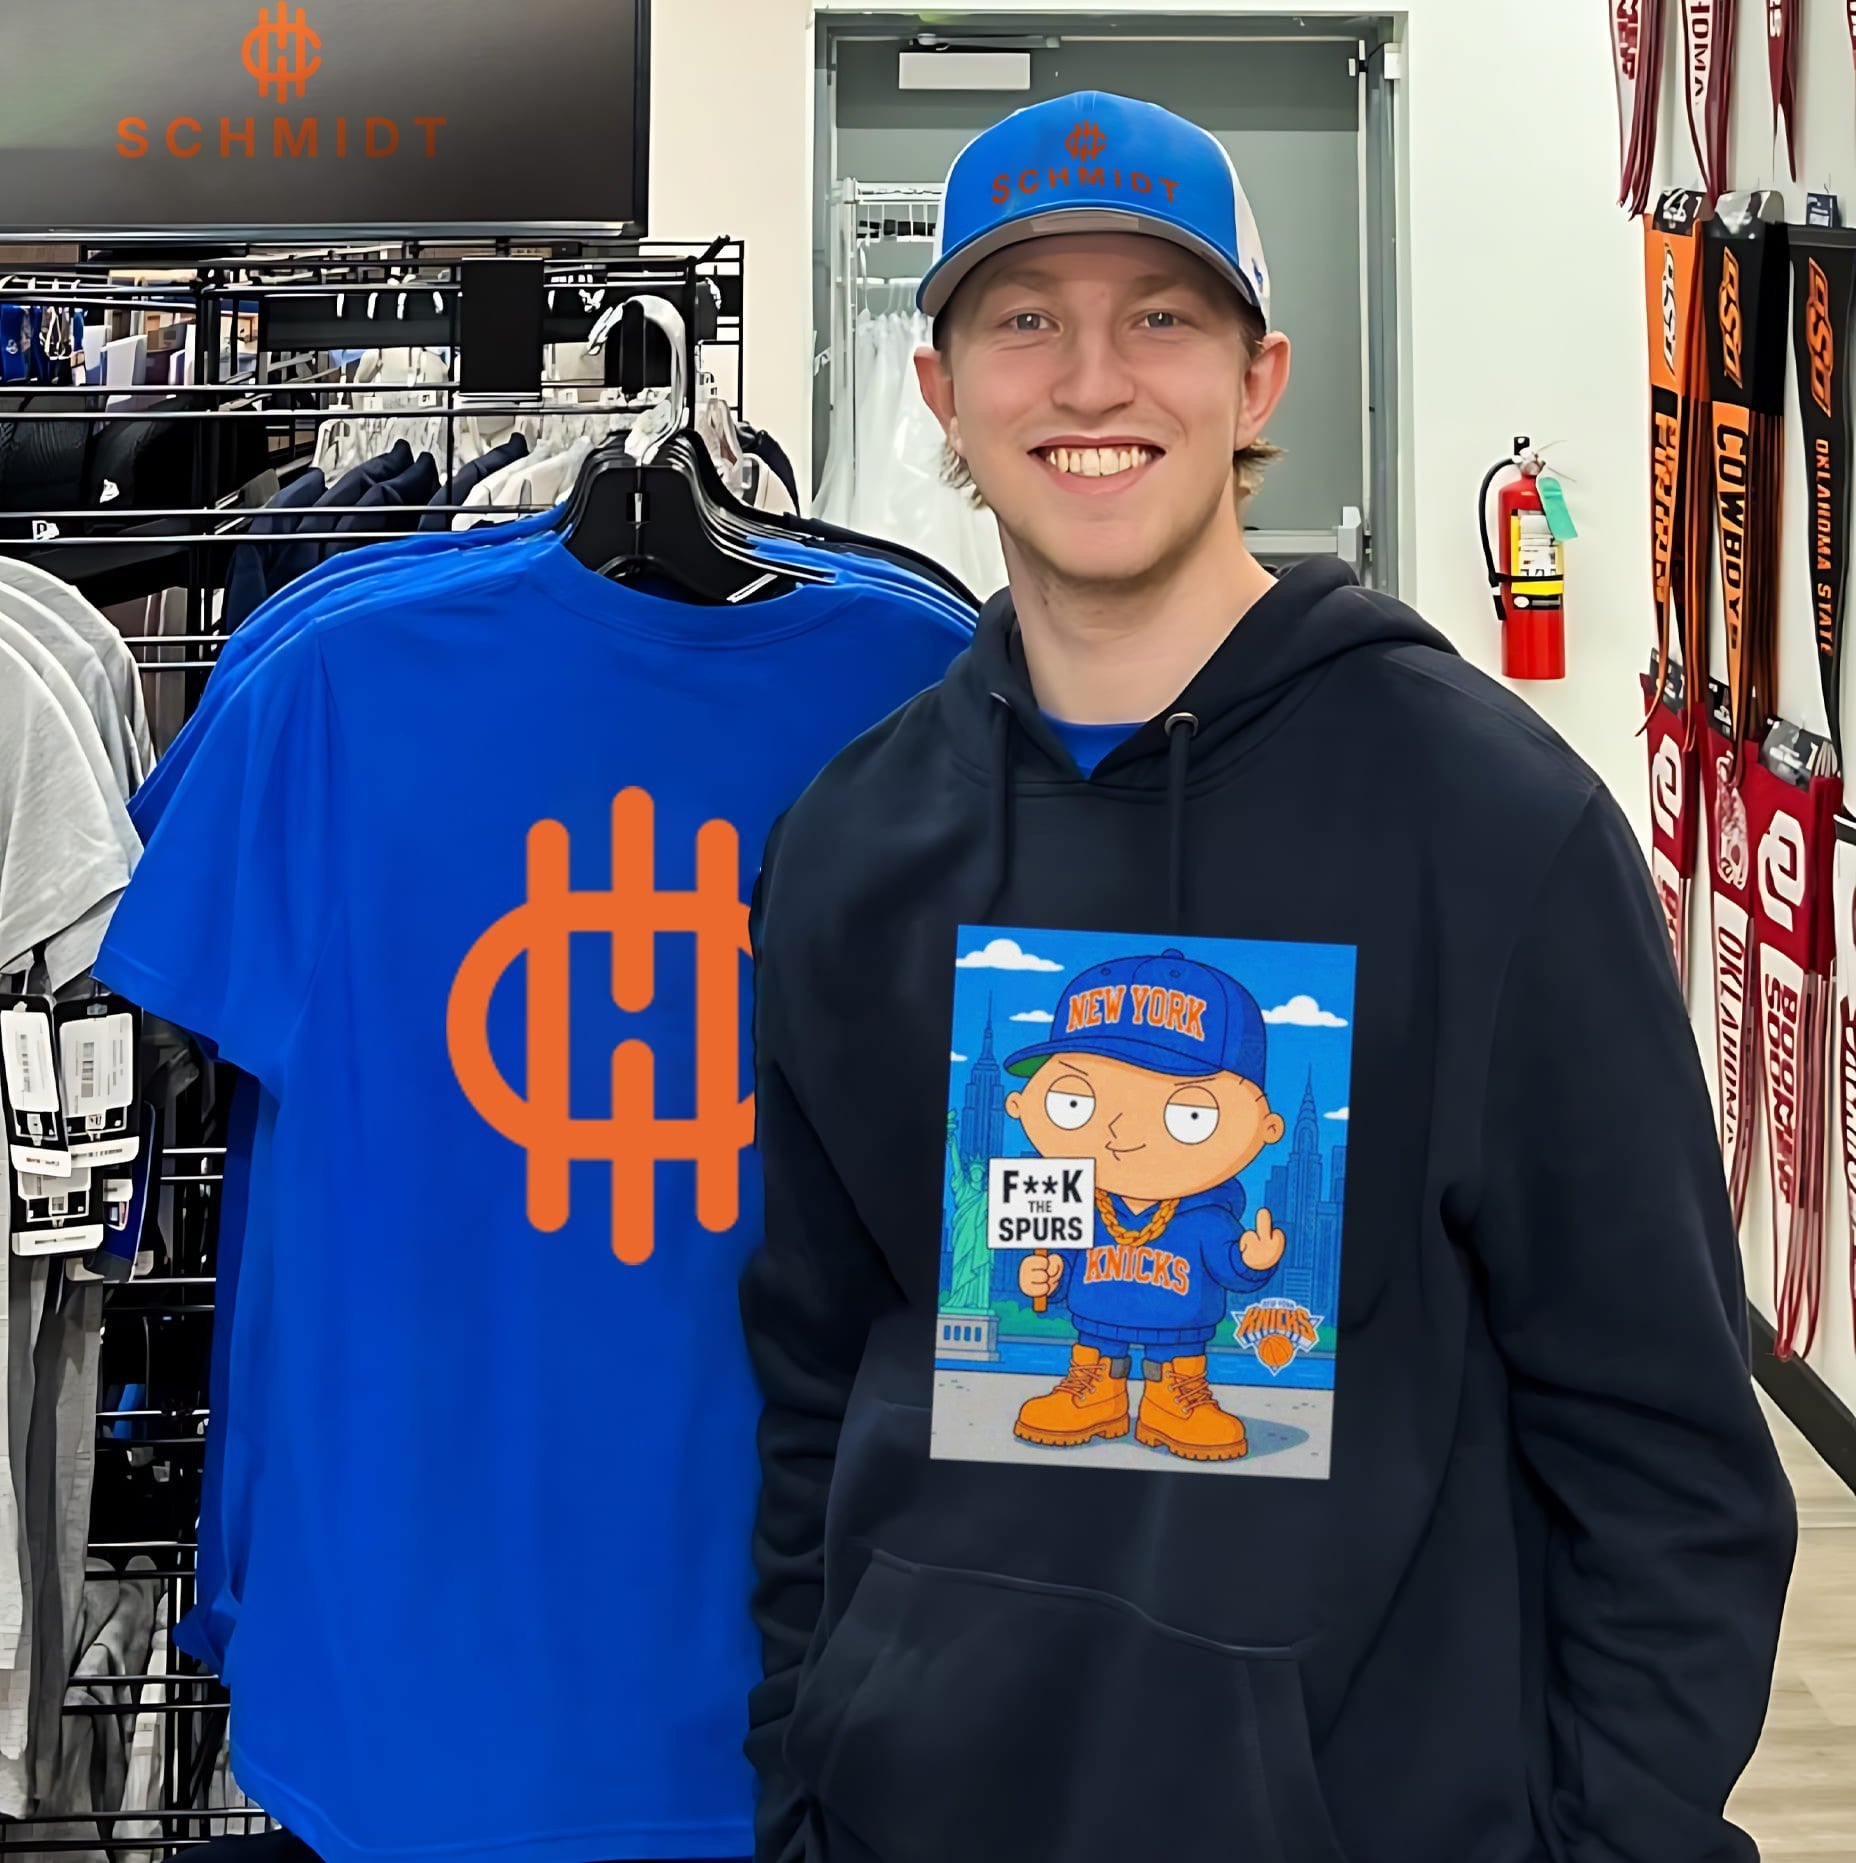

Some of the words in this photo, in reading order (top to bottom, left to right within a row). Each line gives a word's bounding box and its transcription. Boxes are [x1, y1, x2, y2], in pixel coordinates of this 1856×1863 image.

[115, 116, 447, 159] SCHMIDT
[991, 167, 1179, 205] SCHMIDT
[1066, 984, 1127, 1033] NEW
[1130, 984, 1207, 1042] YORK
[1028, 1200, 1052, 1213] THE
[998, 1217, 1083, 1242] SPURS
[1083, 1244, 1191, 1296] KNICKS
[1237, 1305, 1316, 1342] KNICKS
